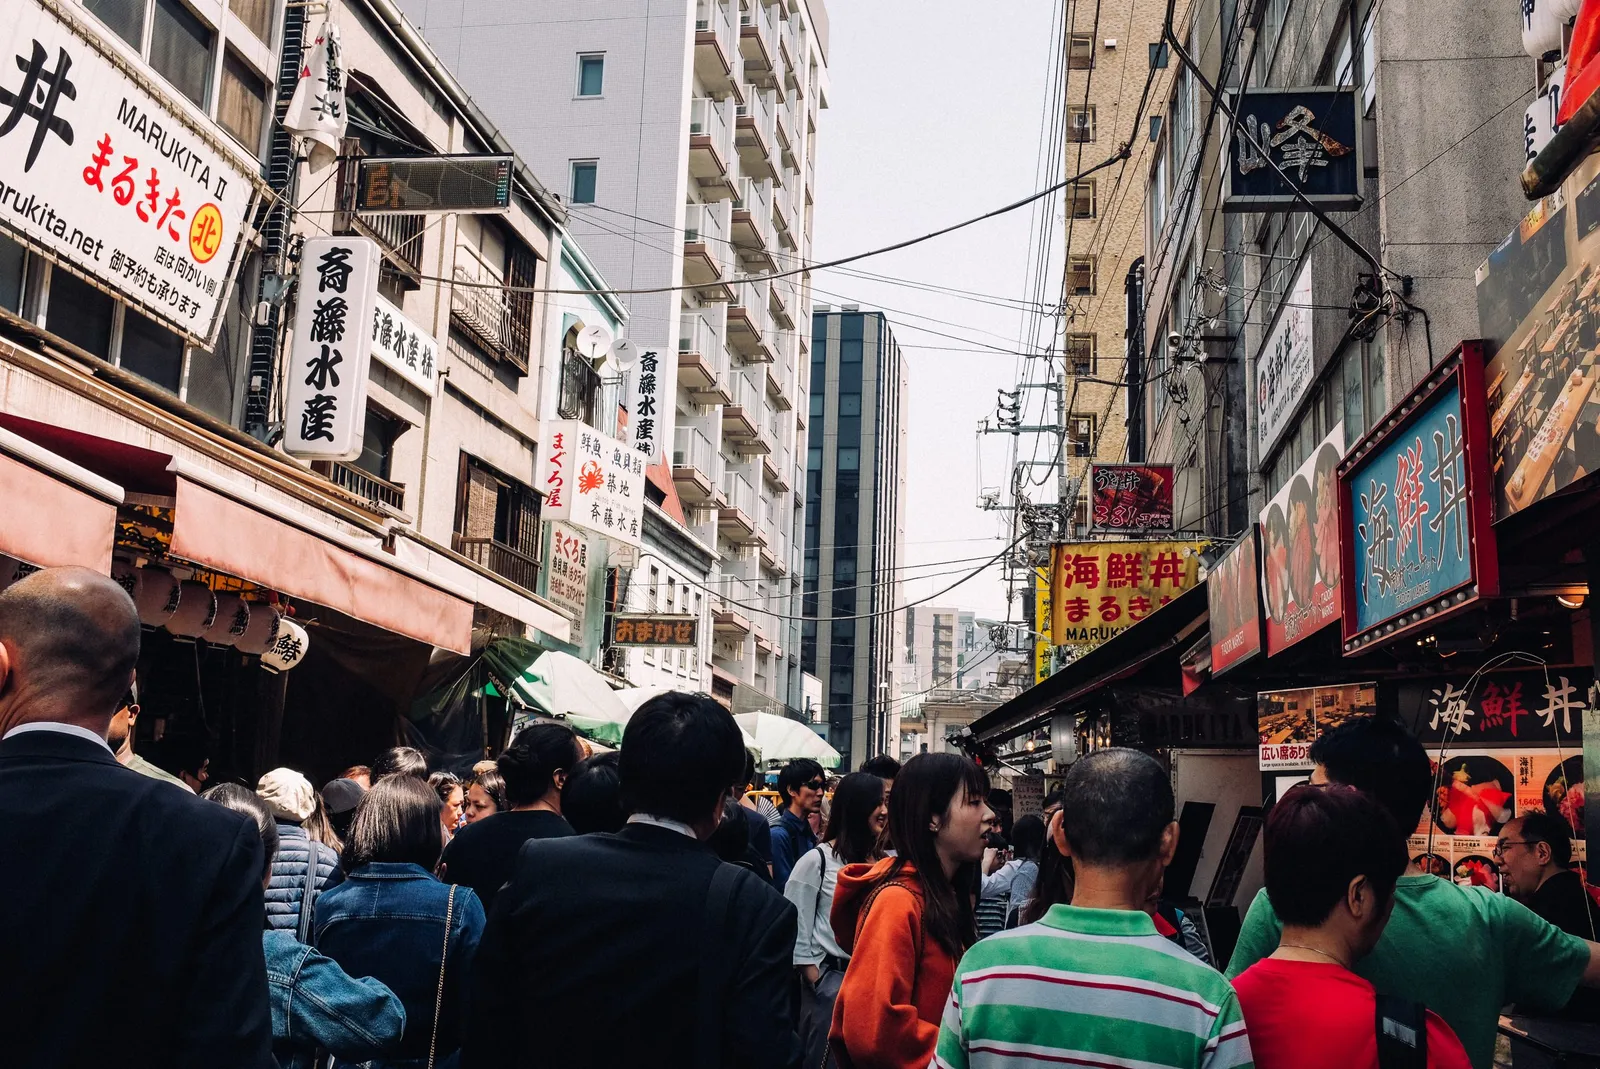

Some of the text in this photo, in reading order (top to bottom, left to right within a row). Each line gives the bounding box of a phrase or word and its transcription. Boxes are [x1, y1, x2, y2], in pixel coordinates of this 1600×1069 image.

[0, 38, 77, 173] 丼
[116, 97, 211, 190] MARUKITA
[83, 133, 187, 242] まるきた
[191, 214, 217, 255] 北
[110, 248, 202, 319] 御予約も承ります
[153, 246, 218, 298] 店は向かい側
[545, 433, 567, 507] まぐろ屋
[606, 472, 630, 498] 築地
[1358, 413, 1466, 607] 海鮮丼
[554, 528, 587, 569] まぐろ屋
[1064, 552, 1186, 590] 海鮮丼
[616, 621, 693, 643] おまかせ
[1428, 676, 1586, 737] 海鮮丼
[1519, 757, 1529, 787] 海鮮丼
